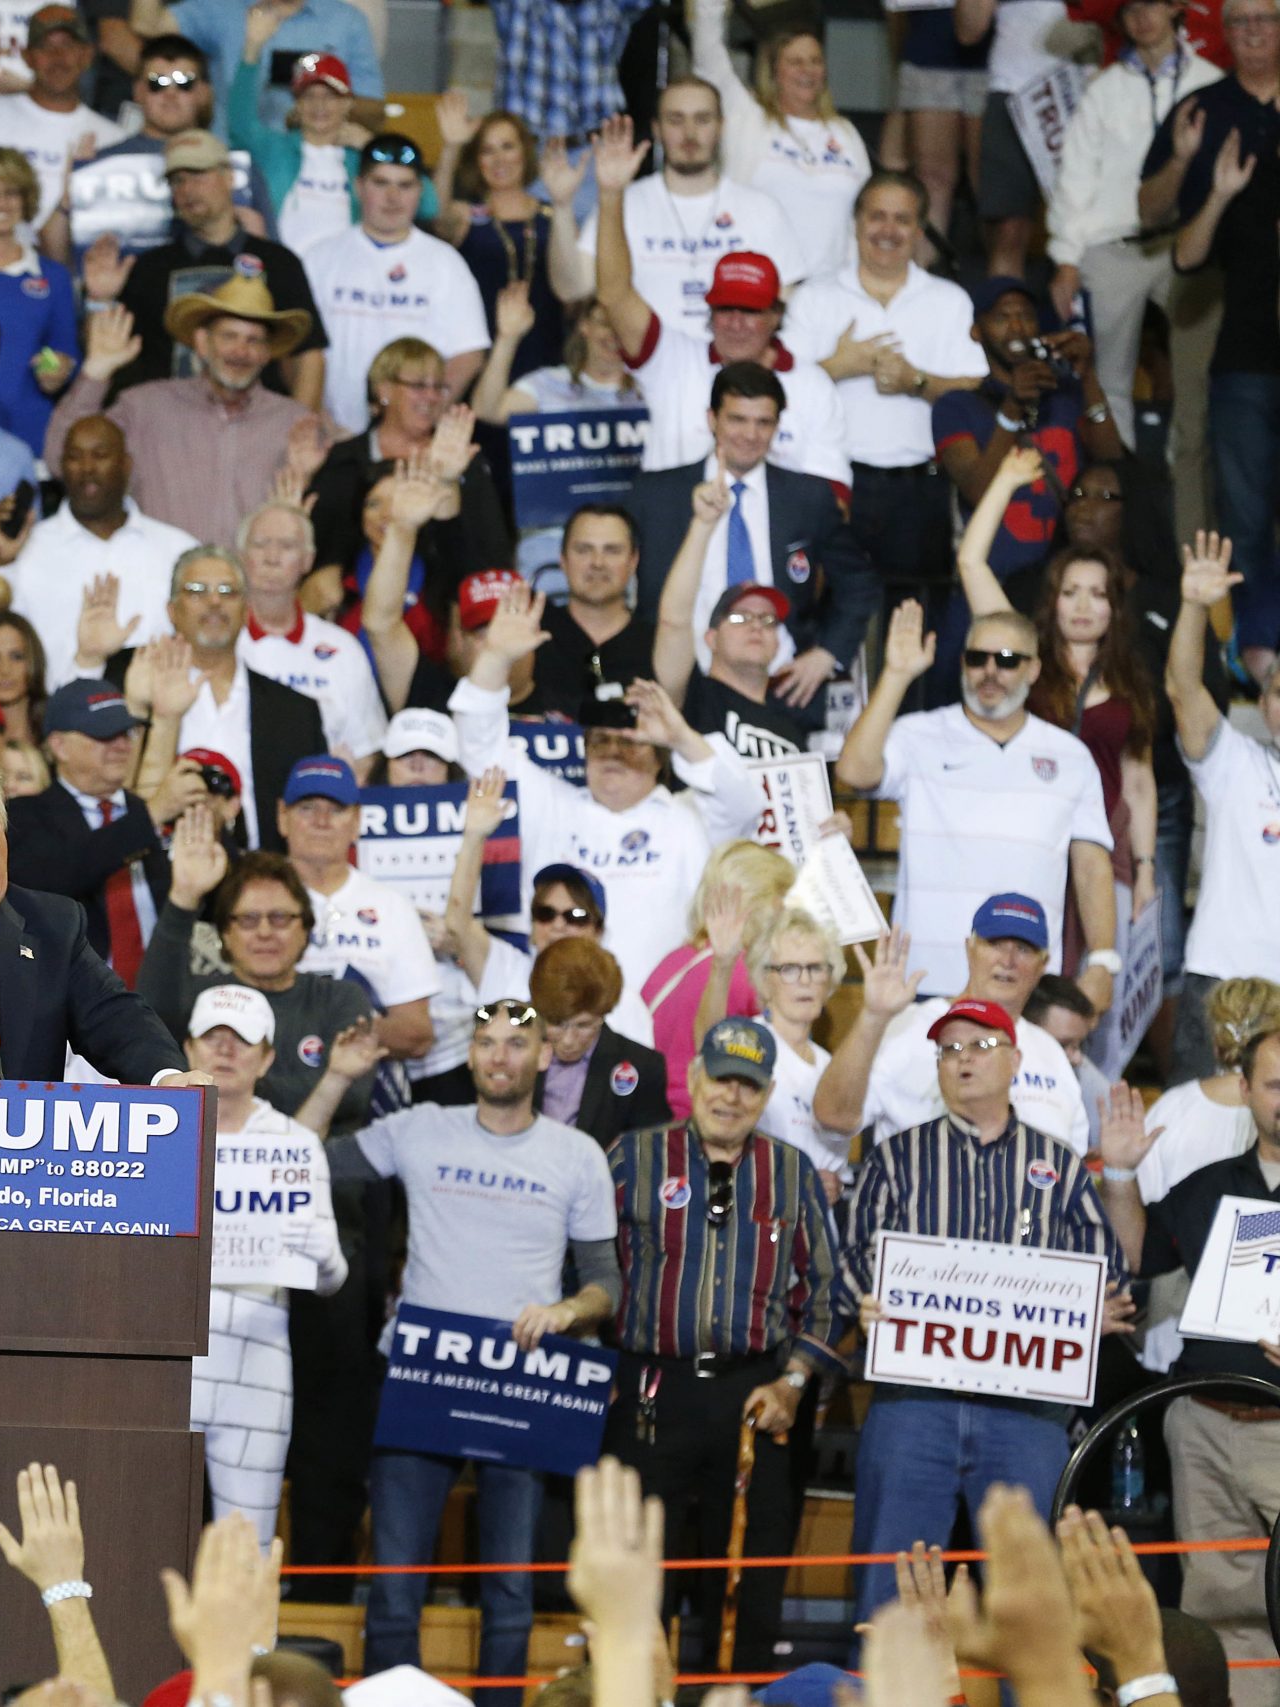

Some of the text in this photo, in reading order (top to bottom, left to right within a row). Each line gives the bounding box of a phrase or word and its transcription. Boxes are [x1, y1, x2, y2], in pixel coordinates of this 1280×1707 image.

[334, 287, 430, 307] TRUMP
[216, 1147, 312, 1164] ETERANS
[47, 1161, 66, 1176] to
[70, 1161, 145, 1178] 88022
[271, 1168, 312, 1184] FOR
[437, 1165, 547, 1193] TRUMP
[39, 1186, 118, 1208] Florida
[214, 1190, 313, 1214] UMP
[28, 1218, 97, 1233] GREAT
[100, 1220, 170, 1236] AGAIN!
[890, 1257, 1090, 1305] the silent majority
[888, 1288, 1087, 1329] STANDS WITH
[396, 1321, 612, 1388] TRUMP
[887, 1317, 1084, 1372] TRUMP
[388, 1364, 606, 1416] MAKE AMERICA GREAT AGAIN!
